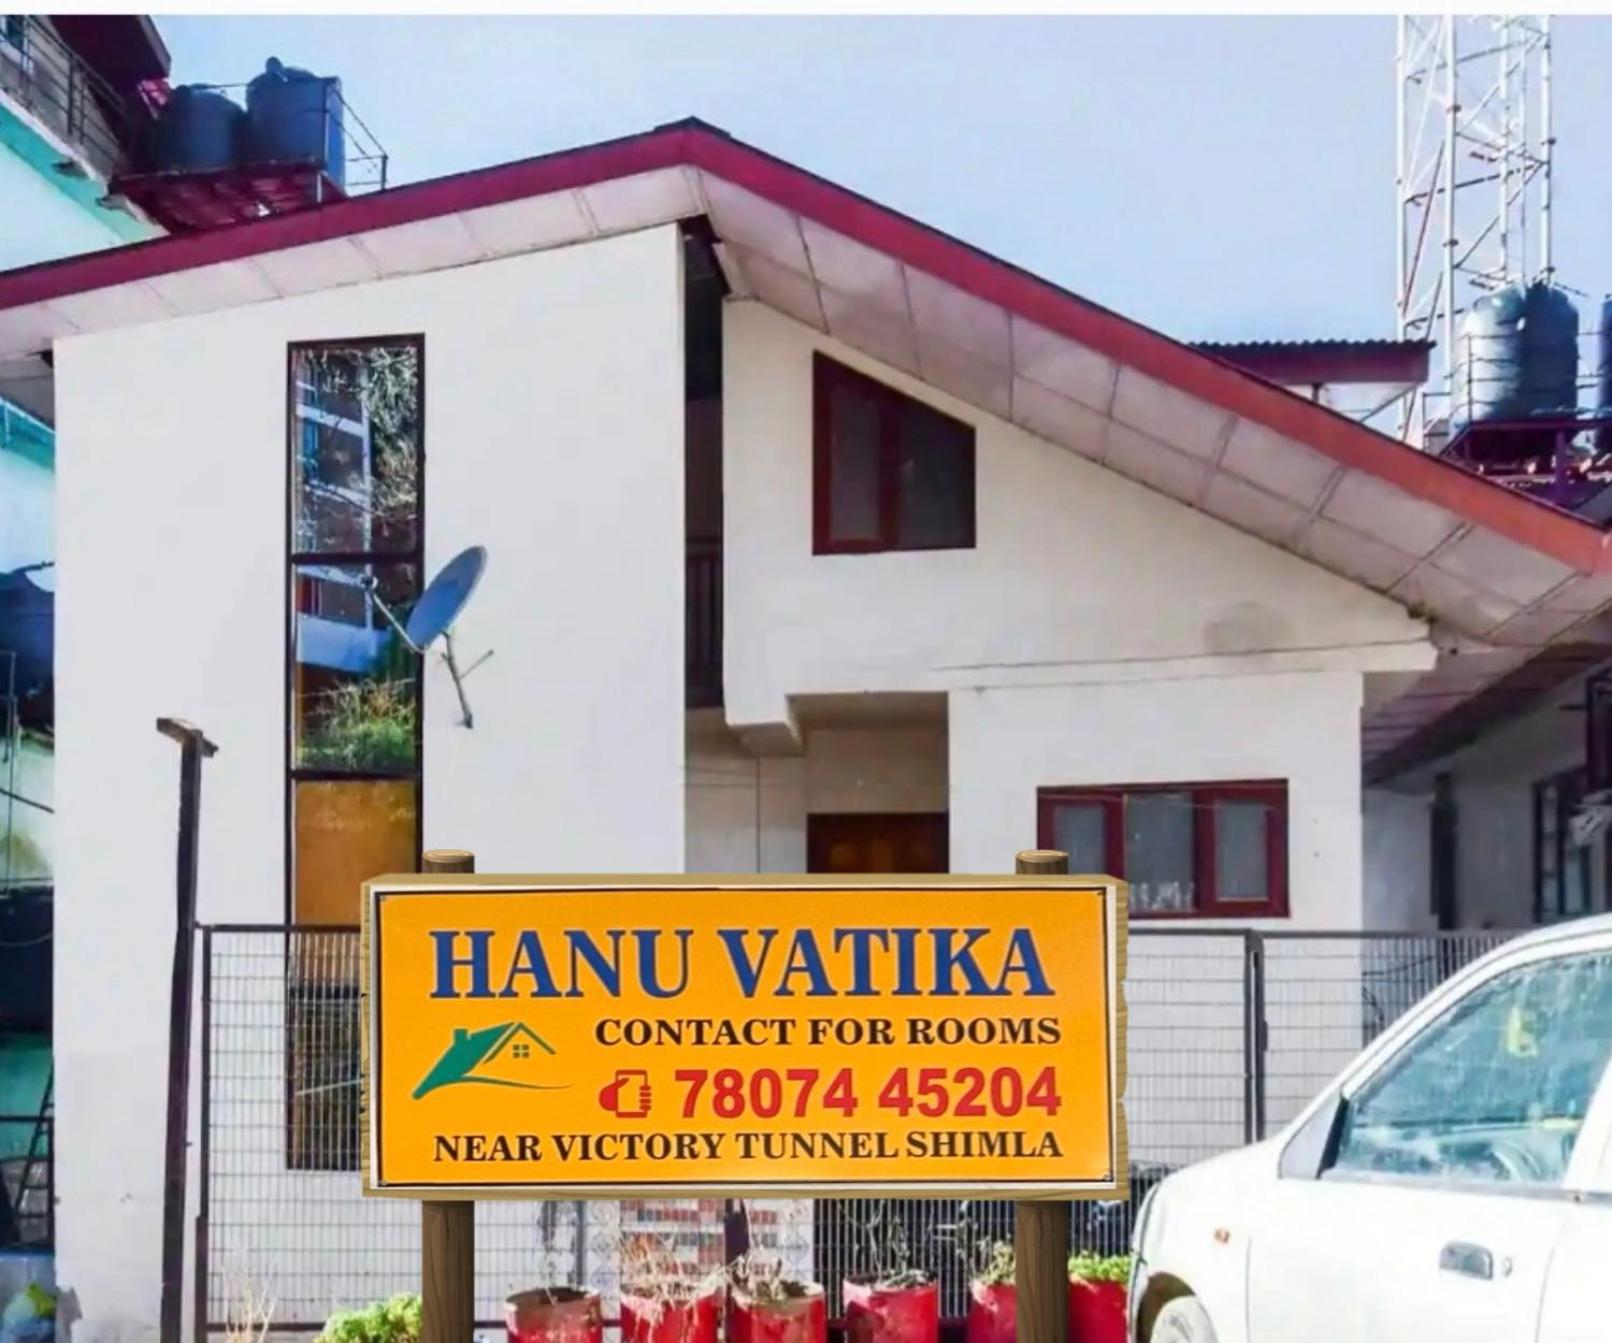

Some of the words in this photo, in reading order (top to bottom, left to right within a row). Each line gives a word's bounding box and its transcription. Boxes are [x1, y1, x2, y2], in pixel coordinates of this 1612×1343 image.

[428, 929, 695, 999] HANU
[716, 928, 1056, 999] VATIKA
[595, 1018, 797, 1047] CONTACT
[807, 1018, 895, 1046] FOR
[906, 1017, 1061, 1045] ROOMS
[674, 1067, 859, 1119] 78074
[878, 1066, 1062, 1118] 45204
[434, 1134, 543, 1162] NEAR
[551, 1132, 726, 1162] VICTORY
[735, 1132, 899, 1159] TUNNEL
[906, 1130, 1063, 1158] SHIMLA
